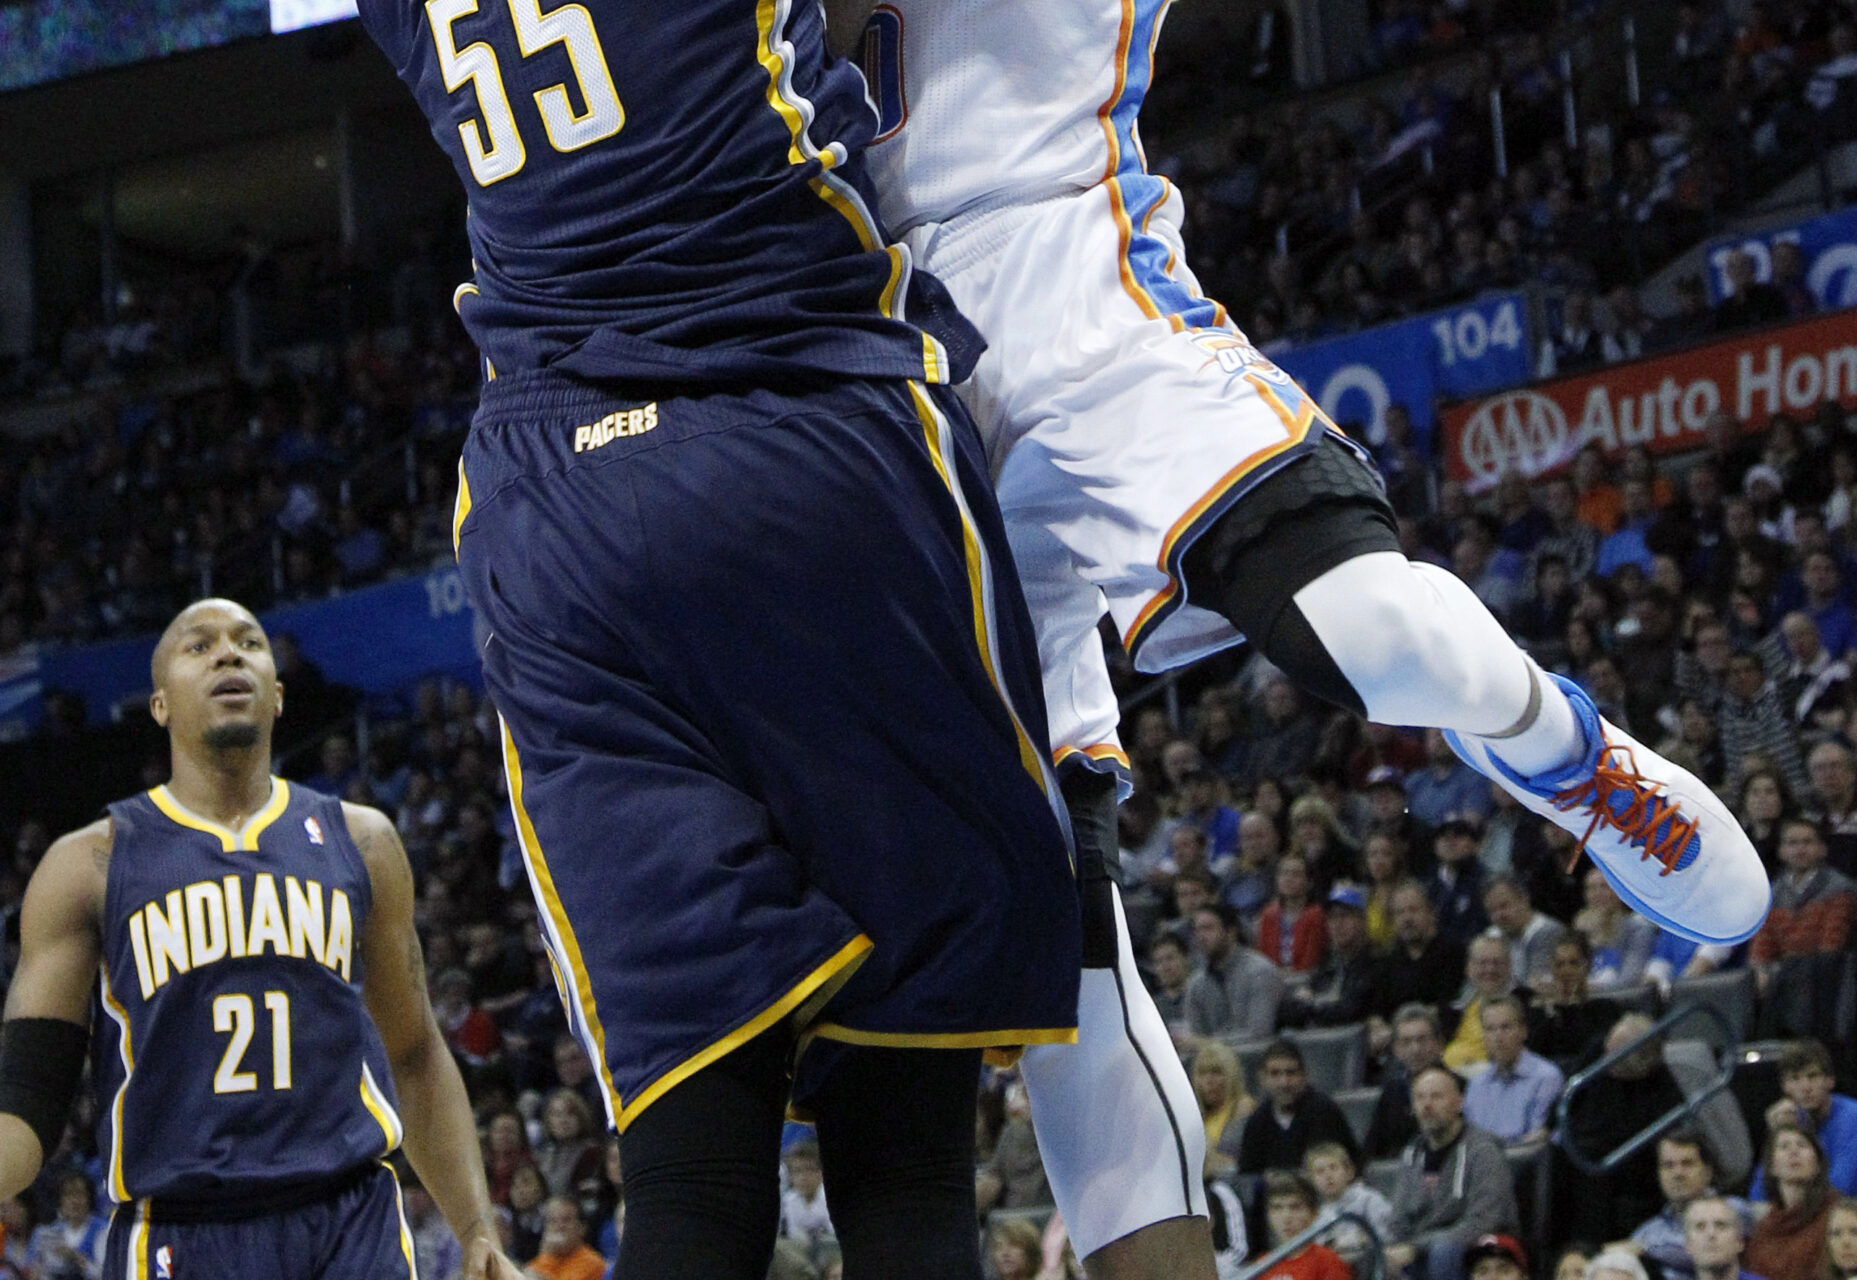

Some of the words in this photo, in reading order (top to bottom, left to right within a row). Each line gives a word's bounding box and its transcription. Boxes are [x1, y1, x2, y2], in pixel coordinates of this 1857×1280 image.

[1432, 303, 1521, 365] 104
[575, 402, 658, 453] PACERS
[1580, 377, 1720, 450] Auto
[425, 574, 463, 619] 10
[129, 872, 353, 1001] INDIANA
[212, 990, 292, 1094] 21
